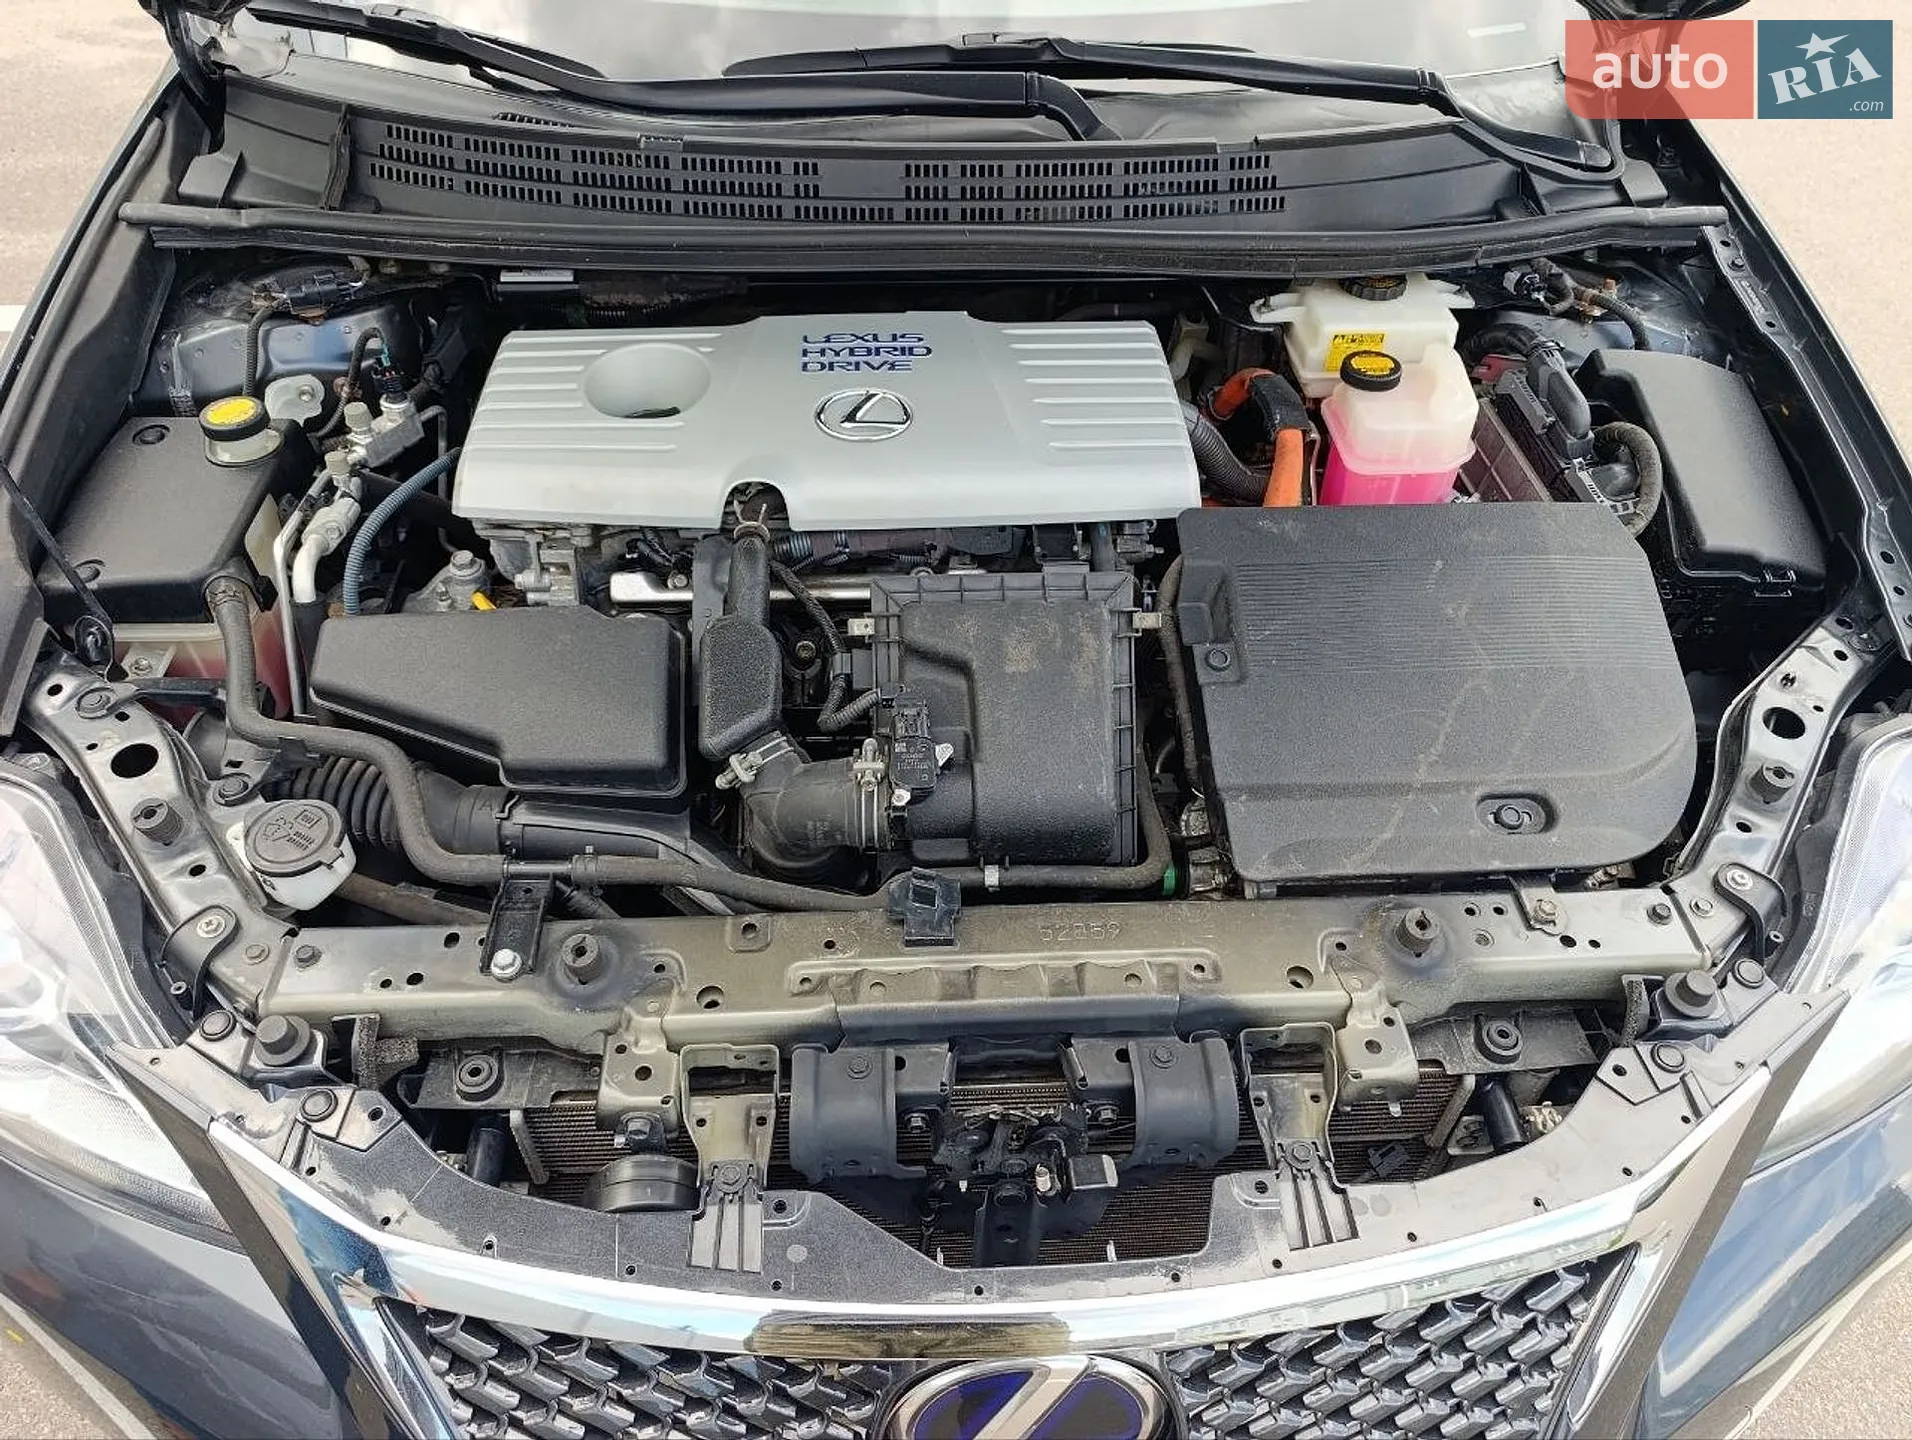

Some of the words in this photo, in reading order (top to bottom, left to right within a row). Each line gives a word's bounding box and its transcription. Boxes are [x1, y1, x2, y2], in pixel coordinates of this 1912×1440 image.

[802, 332, 924, 344] LEXUS
[802, 346, 932, 358] HYBRID
[802, 360, 913, 372] DRIVE
